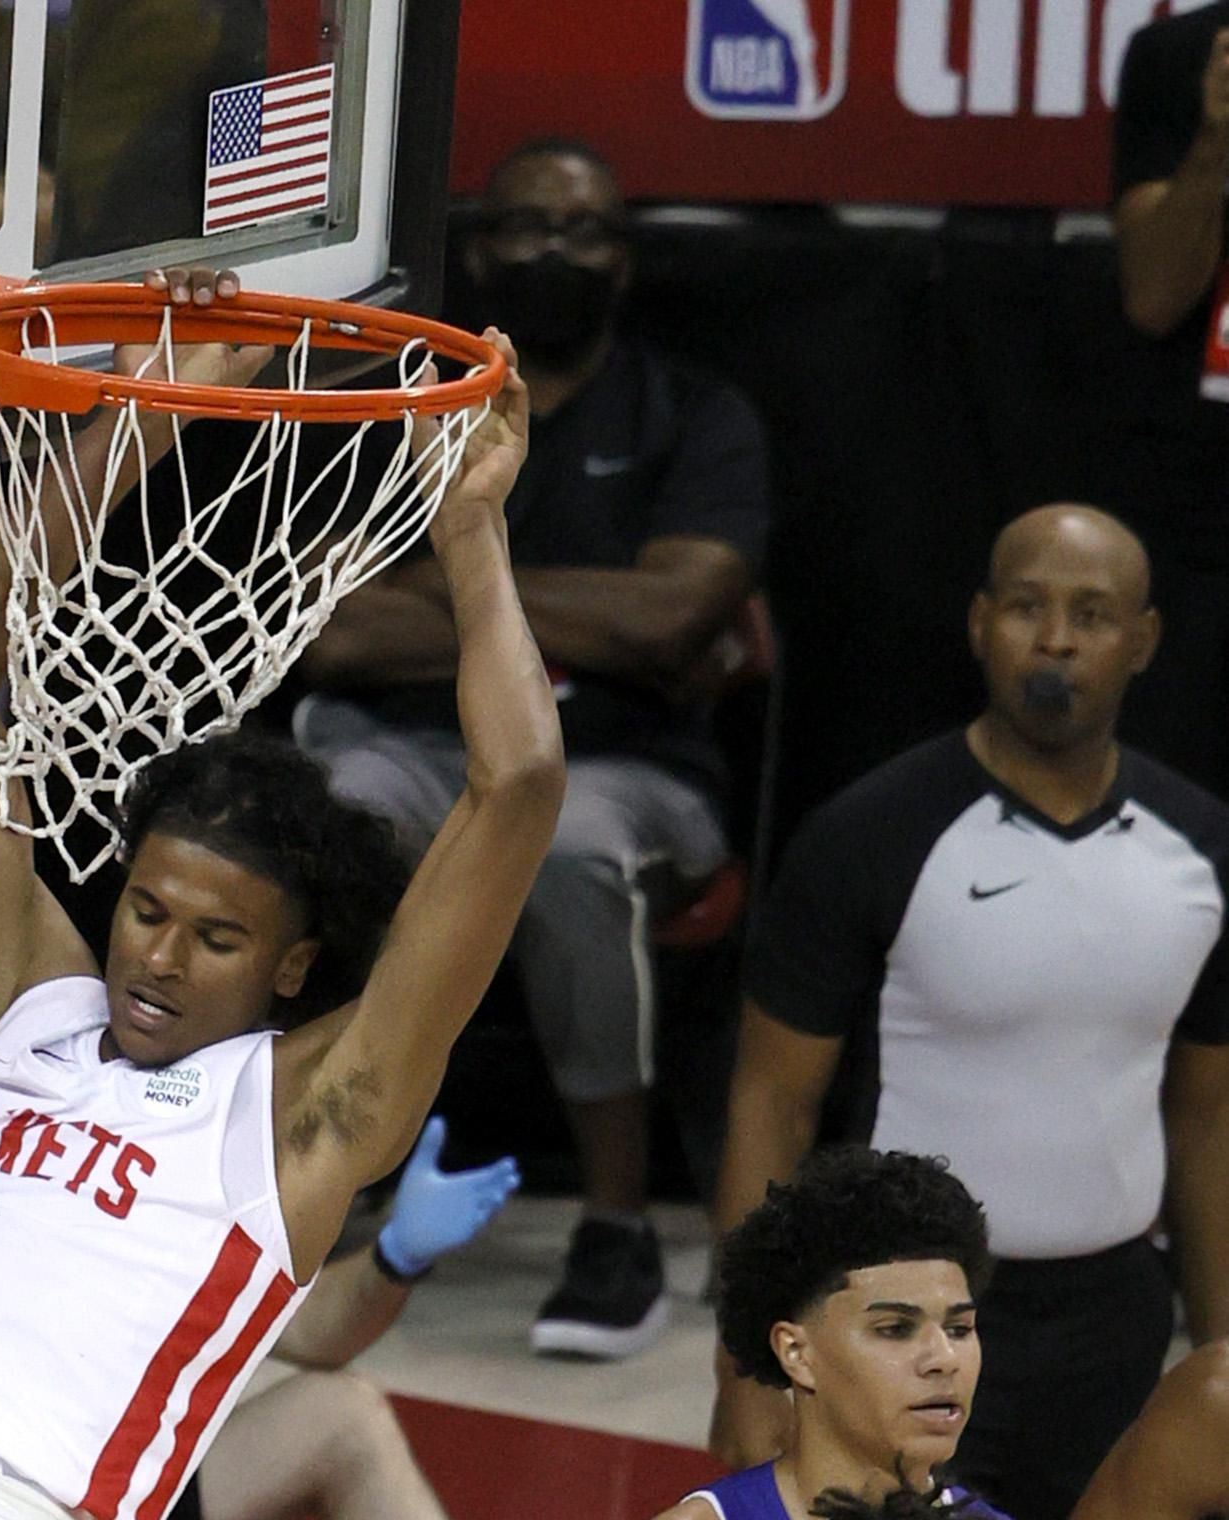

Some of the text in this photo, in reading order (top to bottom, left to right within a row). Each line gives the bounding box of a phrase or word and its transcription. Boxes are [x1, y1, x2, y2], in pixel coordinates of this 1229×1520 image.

[155, 1067, 202, 1084] credit
[146, 1078, 200, 1097] karma
[144, 1090, 194, 1107] MONEY
